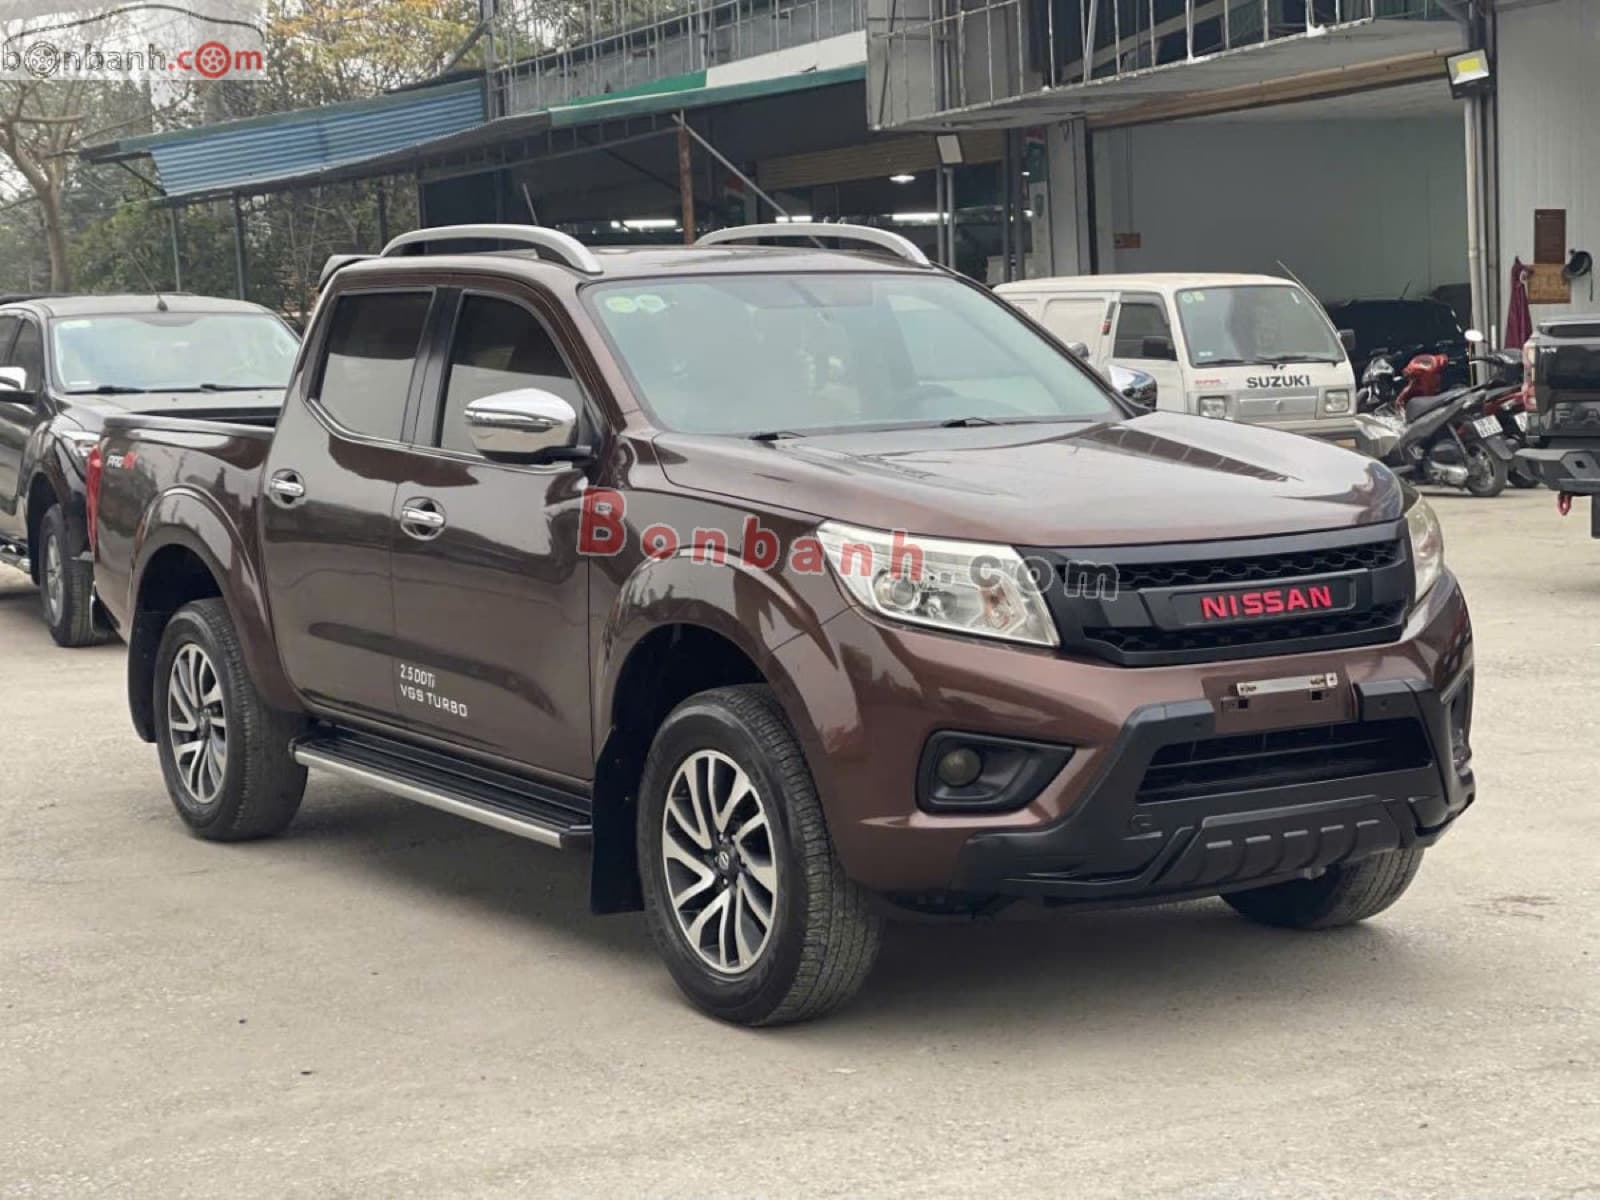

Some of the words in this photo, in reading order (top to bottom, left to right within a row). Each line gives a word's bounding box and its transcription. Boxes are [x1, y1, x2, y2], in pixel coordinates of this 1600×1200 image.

[1246, 375, 1311, 389] SUZUKI
[1201, 586, 1333, 619] NISSAN
[426, 692, 468, 717] TURBO
